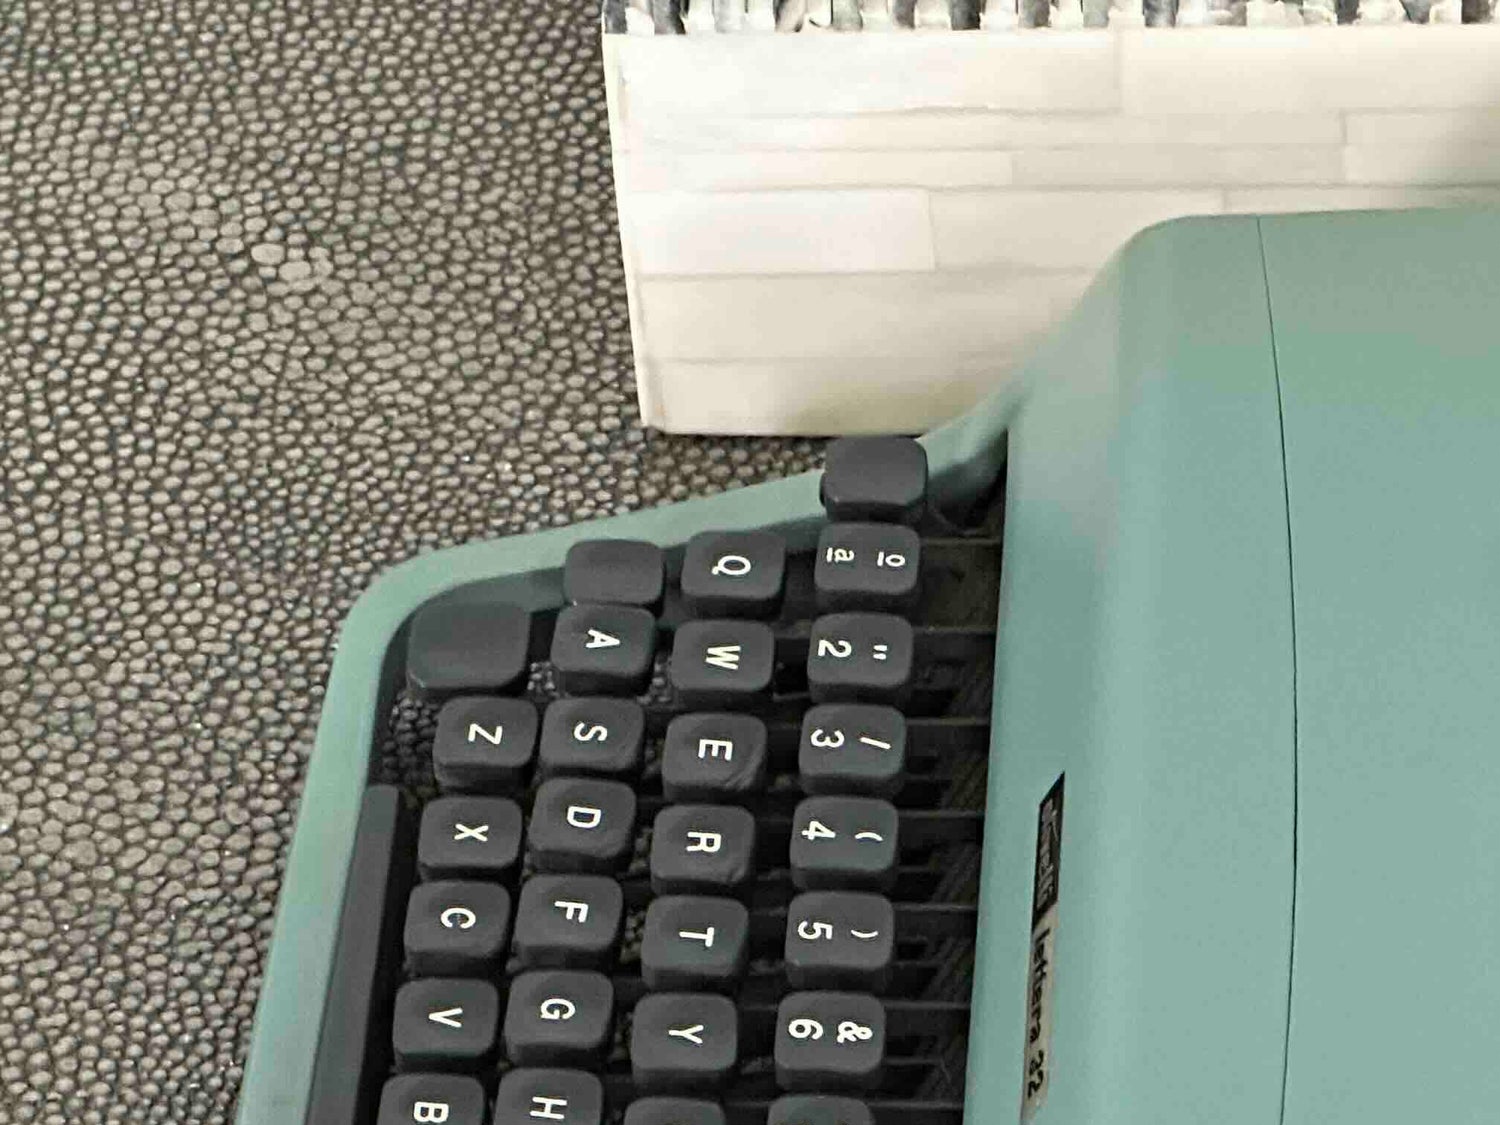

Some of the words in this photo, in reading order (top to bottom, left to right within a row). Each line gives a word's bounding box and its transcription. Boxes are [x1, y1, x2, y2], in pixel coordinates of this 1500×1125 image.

[711, 555, 752, 576] Q
[585, 629, 621, 649] A
[817, 639, 852, 658] 2
[705, 645, 741, 670] W
[873, 644, 888, 660] "
[467, 723, 503, 745] Z
[573, 722, 608, 742] S
[810, 728, 845, 748] 3
[697, 738, 733, 761] E
[860, 736, 891, 750] /
[566, 805, 602, 829] D
[454, 823, 489, 842] X
[801, 820, 836, 841] 4
[854, 831, 883, 842] (
[686, 831, 722, 853] R
[440, 907, 476, 929] C
[554, 900, 589, 923] F
[679, 926, 715, 948] T
[797, 920, 833, 940] 5
[850, 929, 879, 939] )
[428, 1007, 463, 1028] V
[540, 998, 576, 1020] G
[668, 1024, 704, 1044] Y
[788, 1018, 824, 1040] 6
[836, 1021, 873, 1044] &
[413, 1101, 449, 1124] B
[529, 1096, 568, 1120] H
